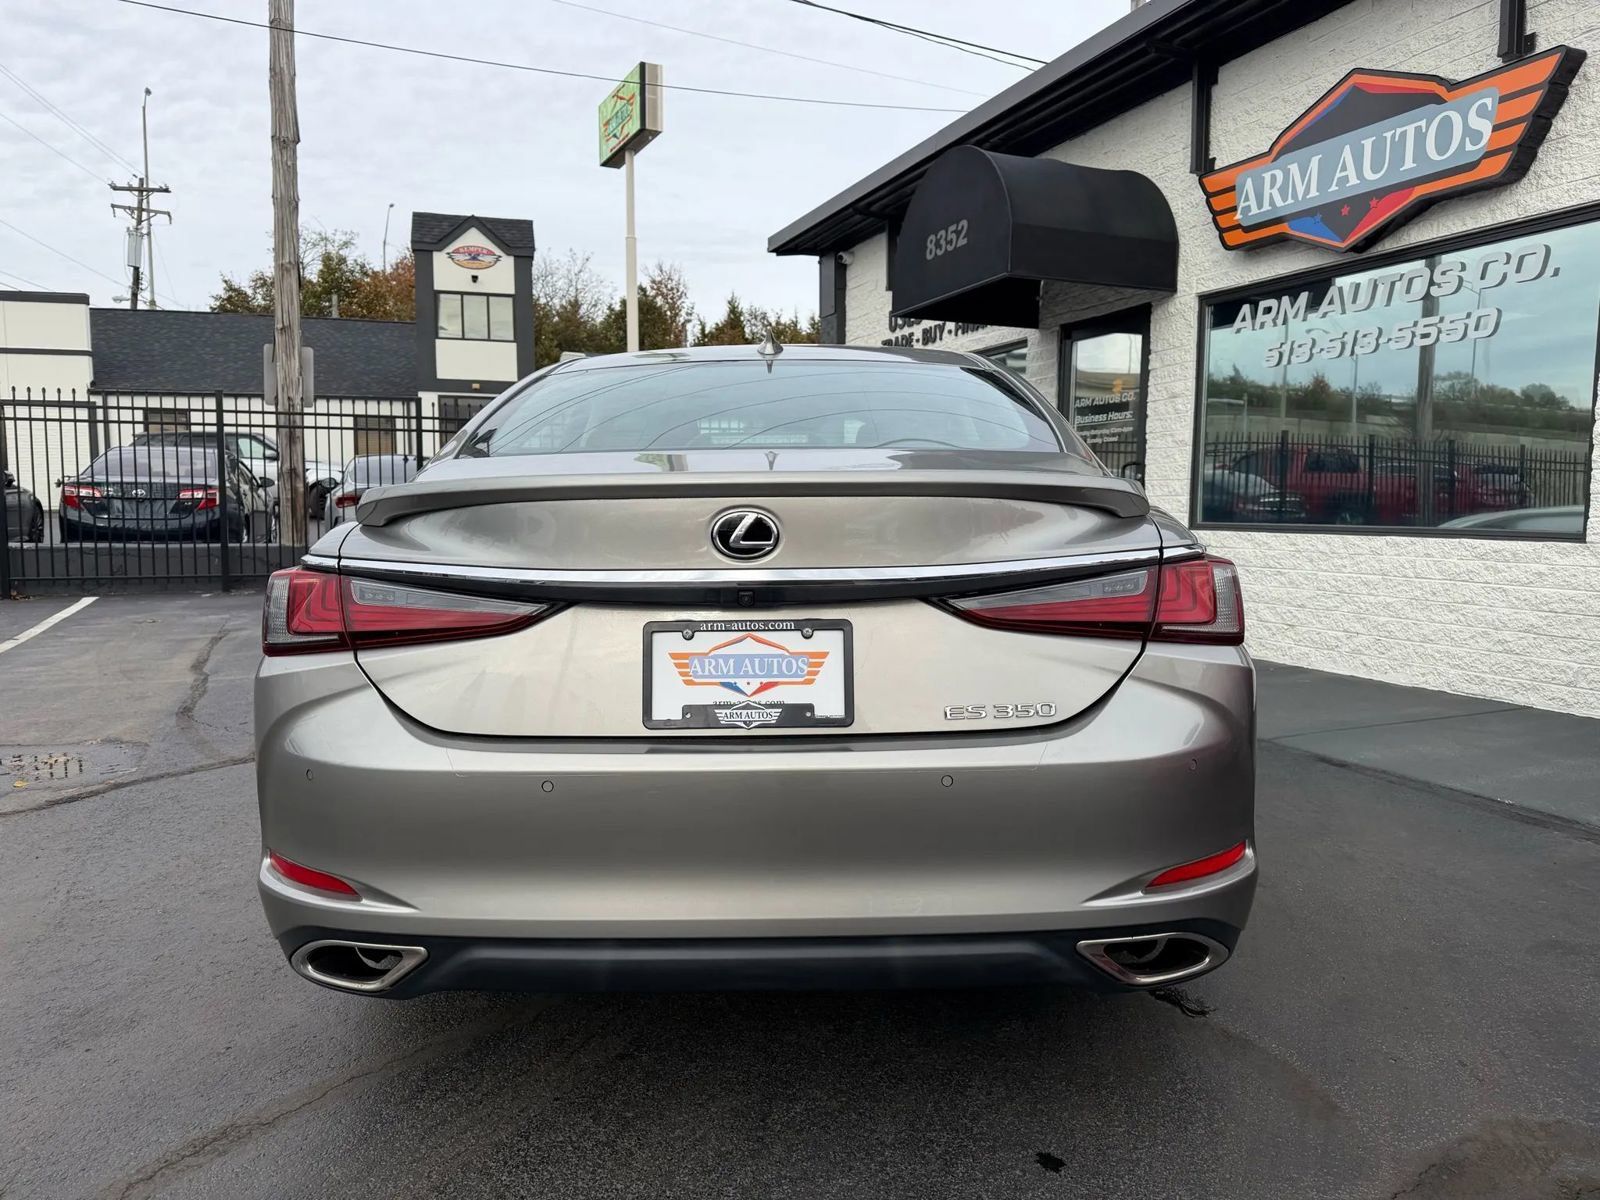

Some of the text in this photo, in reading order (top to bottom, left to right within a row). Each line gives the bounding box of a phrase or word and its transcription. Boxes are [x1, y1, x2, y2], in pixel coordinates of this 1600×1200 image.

[1233, 97, 1493, 220] ARM AUTOS
[926, 219, 969, 260] 8352
[1232, 243, 1561, 334] ARM AUTOS CO.
[921, 321, 946, 346] BUY
[1264, 306, 1502, 369] 513-513-5550
[1074, 397, 1092, 409] ARM
[1093, 393, 1121, 406] AUTOS
[1074, 413, 1107, 425] Business
[699, 620, 795, 631] arm-autos.com
[689, 657, 809, 676] ARM AUTOS
[722, 711, 774, 720] ARM AUTOS
[944, 701, 1057, 720] ES 350
